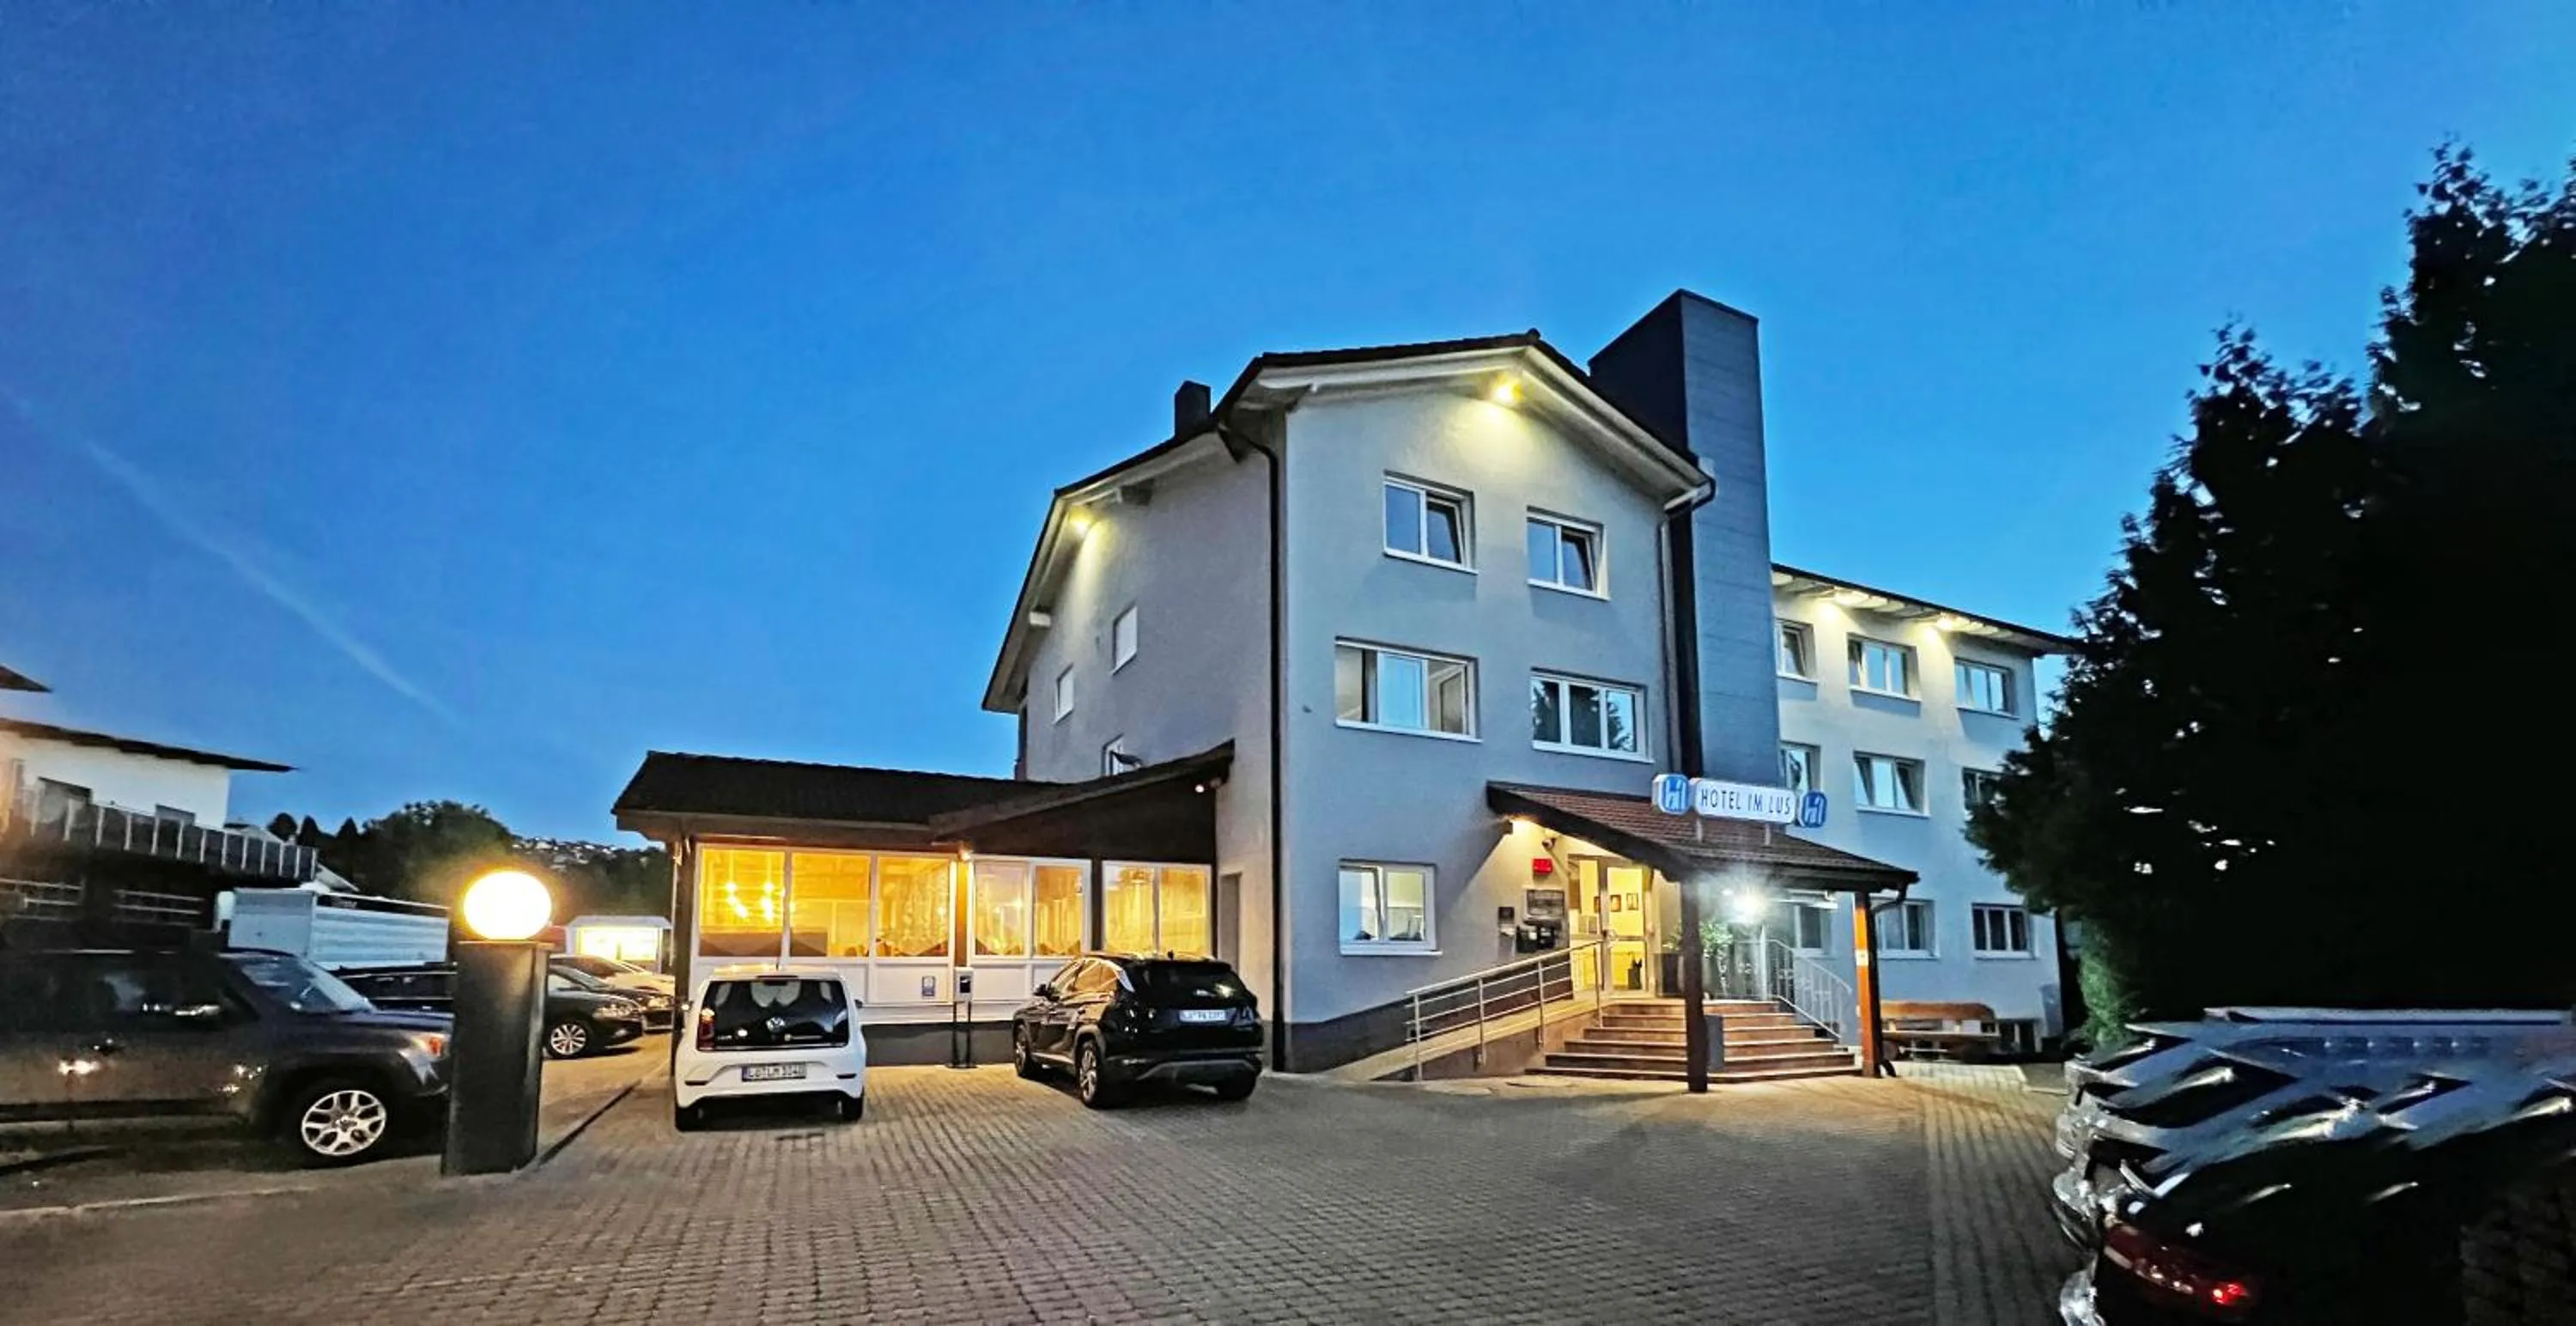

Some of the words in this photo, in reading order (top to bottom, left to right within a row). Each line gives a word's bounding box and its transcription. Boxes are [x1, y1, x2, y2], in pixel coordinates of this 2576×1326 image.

[1701, 788, 1741, 811] HOTEL
[1747, 793, 1763, 812] IM
[1769, 795, 1790, 815] LUS
